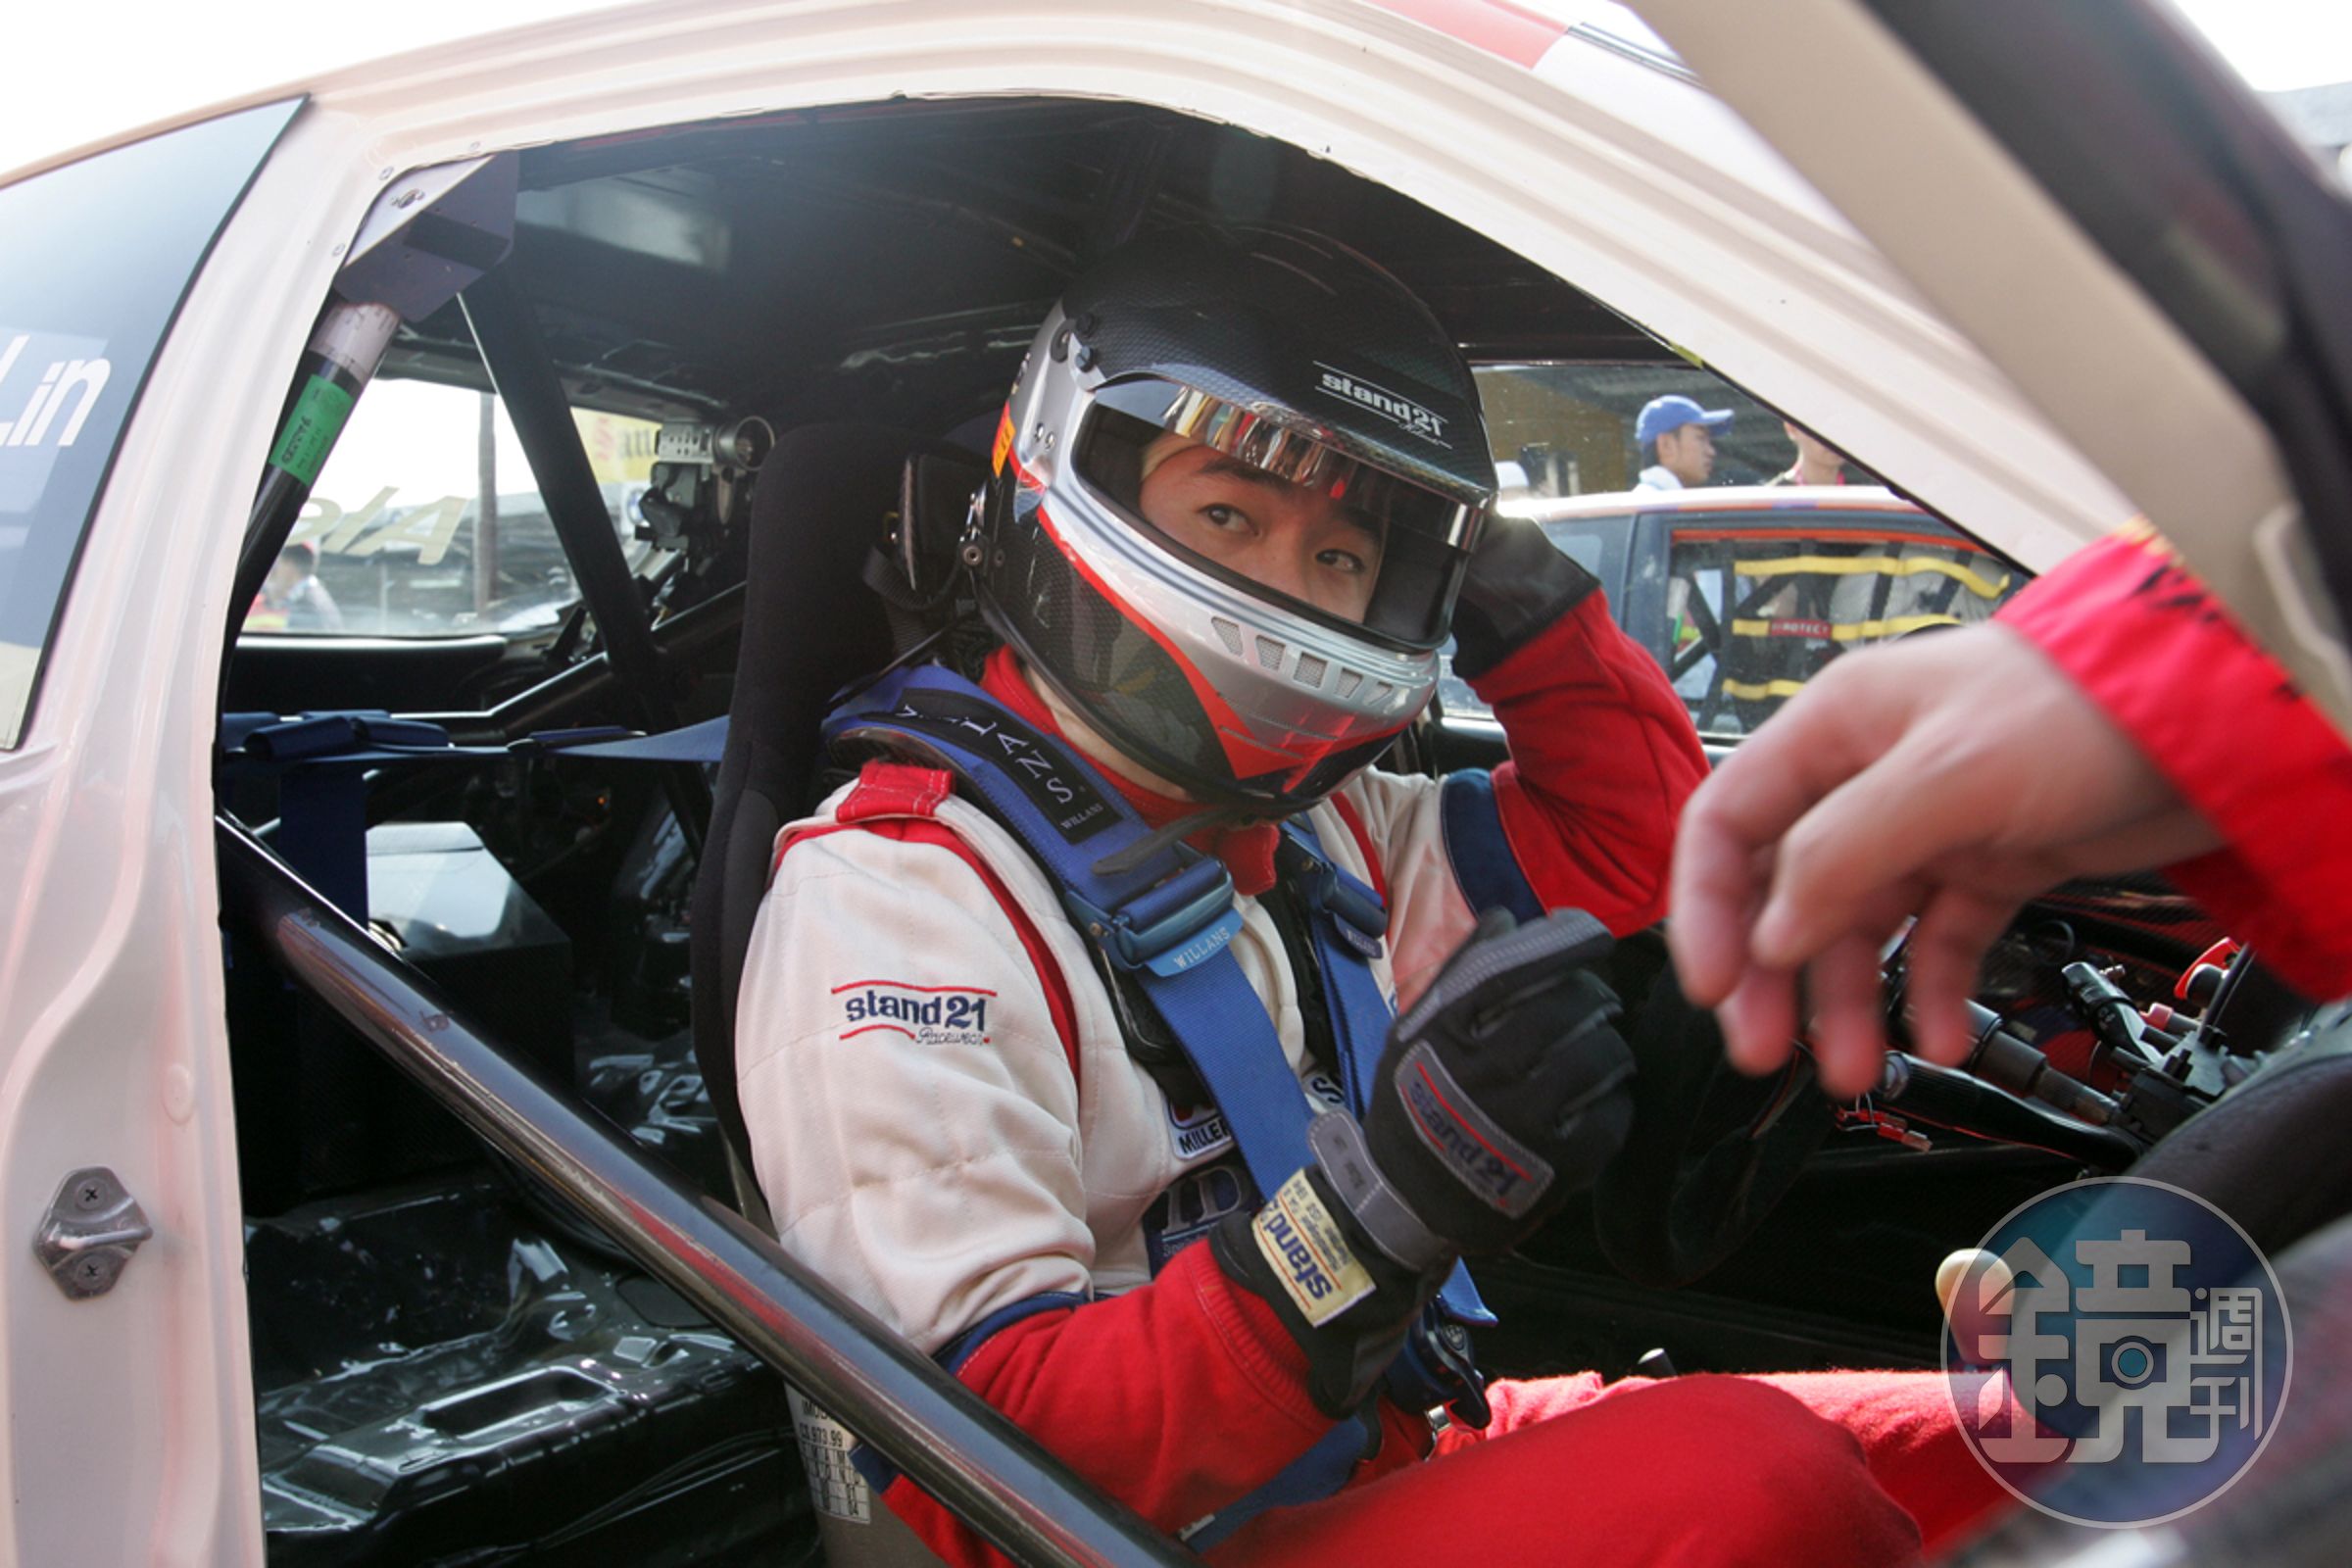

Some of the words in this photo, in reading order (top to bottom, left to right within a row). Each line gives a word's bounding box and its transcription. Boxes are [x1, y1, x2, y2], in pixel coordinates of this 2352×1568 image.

[1322, 373, 1442, 436] stand21
[1173, 926, 1230, 969] WILLANS
[846, 990, 986, 1032] stand21
